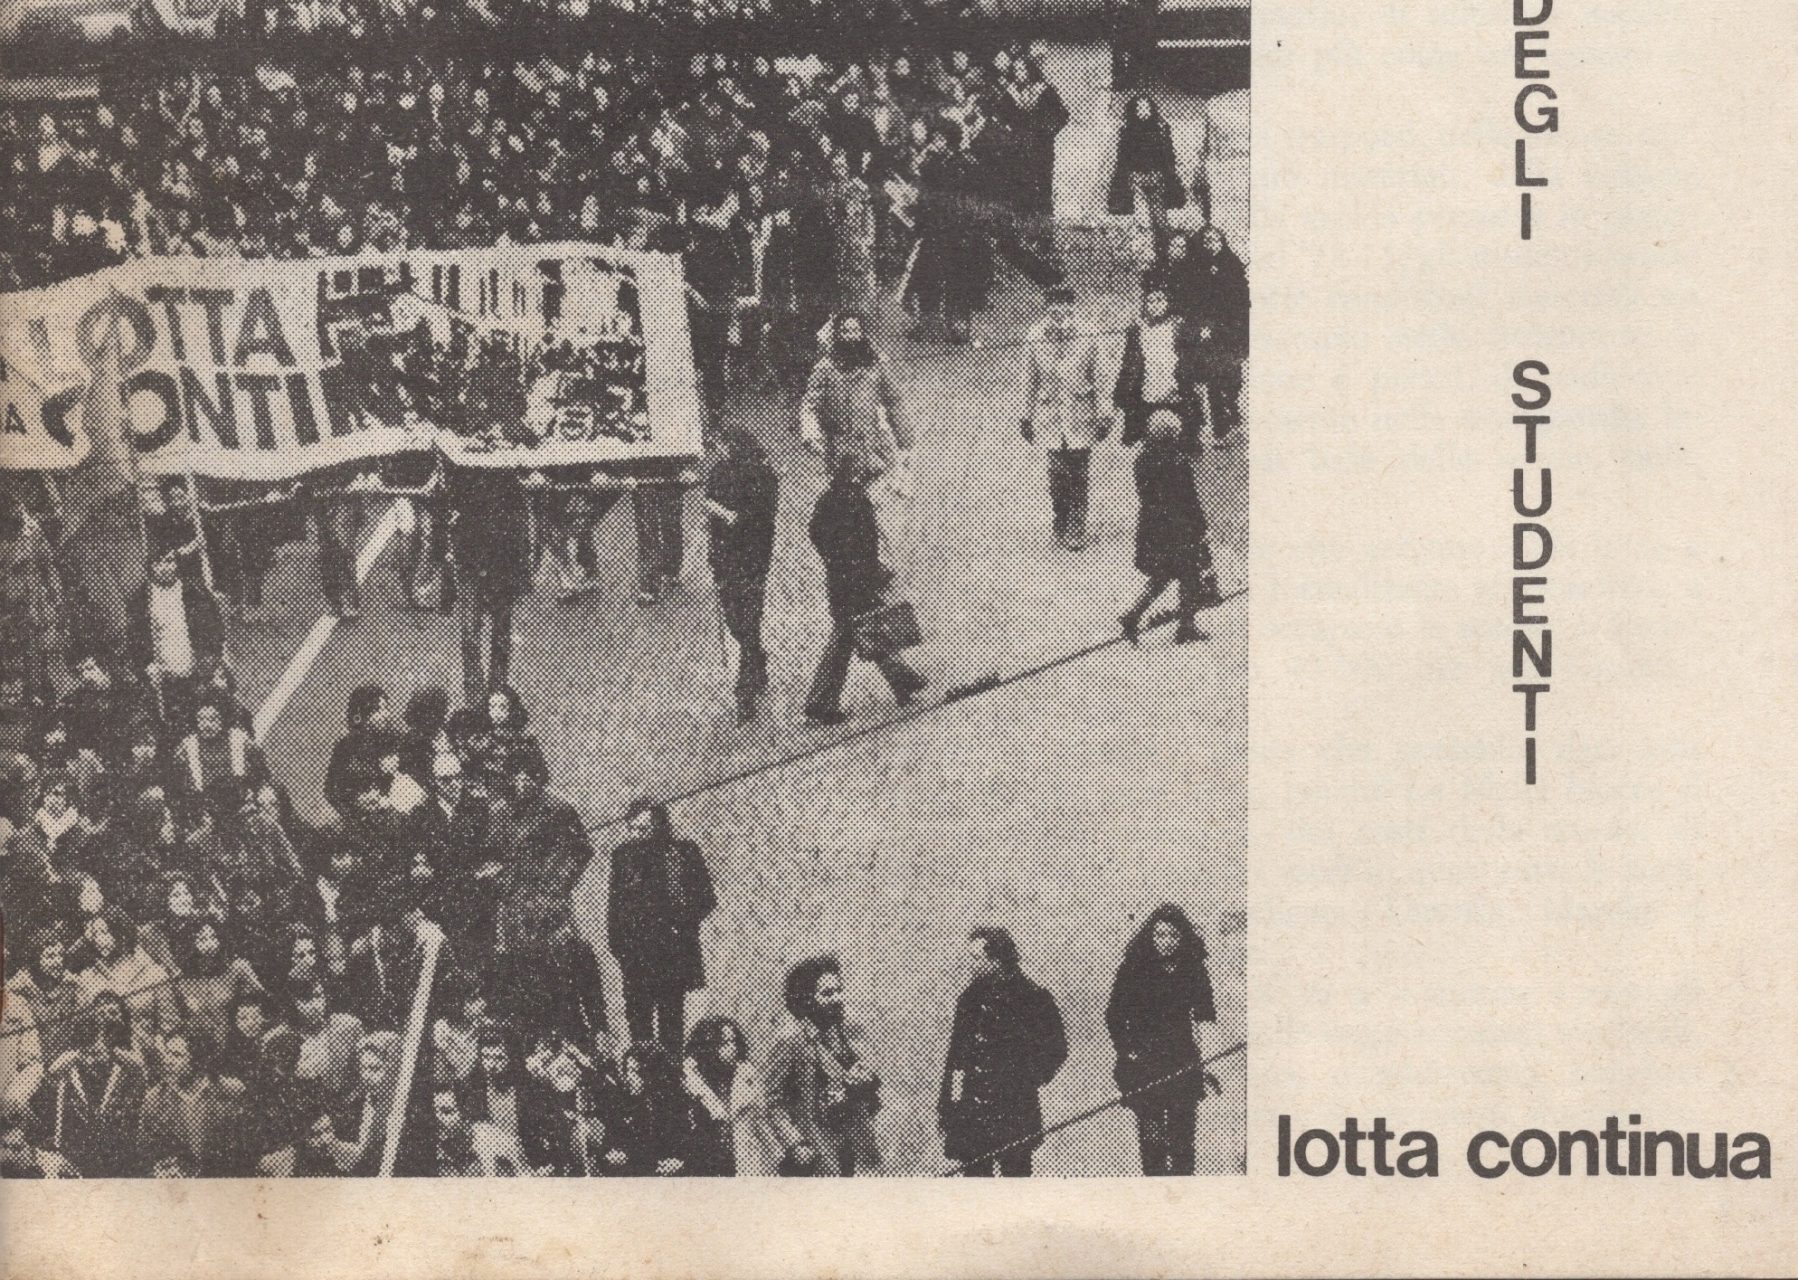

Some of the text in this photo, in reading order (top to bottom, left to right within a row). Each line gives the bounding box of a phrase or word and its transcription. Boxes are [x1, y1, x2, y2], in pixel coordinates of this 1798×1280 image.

[1510, 359, 1553, 785] STUDENTI
[1278, 1114, 1772, 1180] lotta continua
